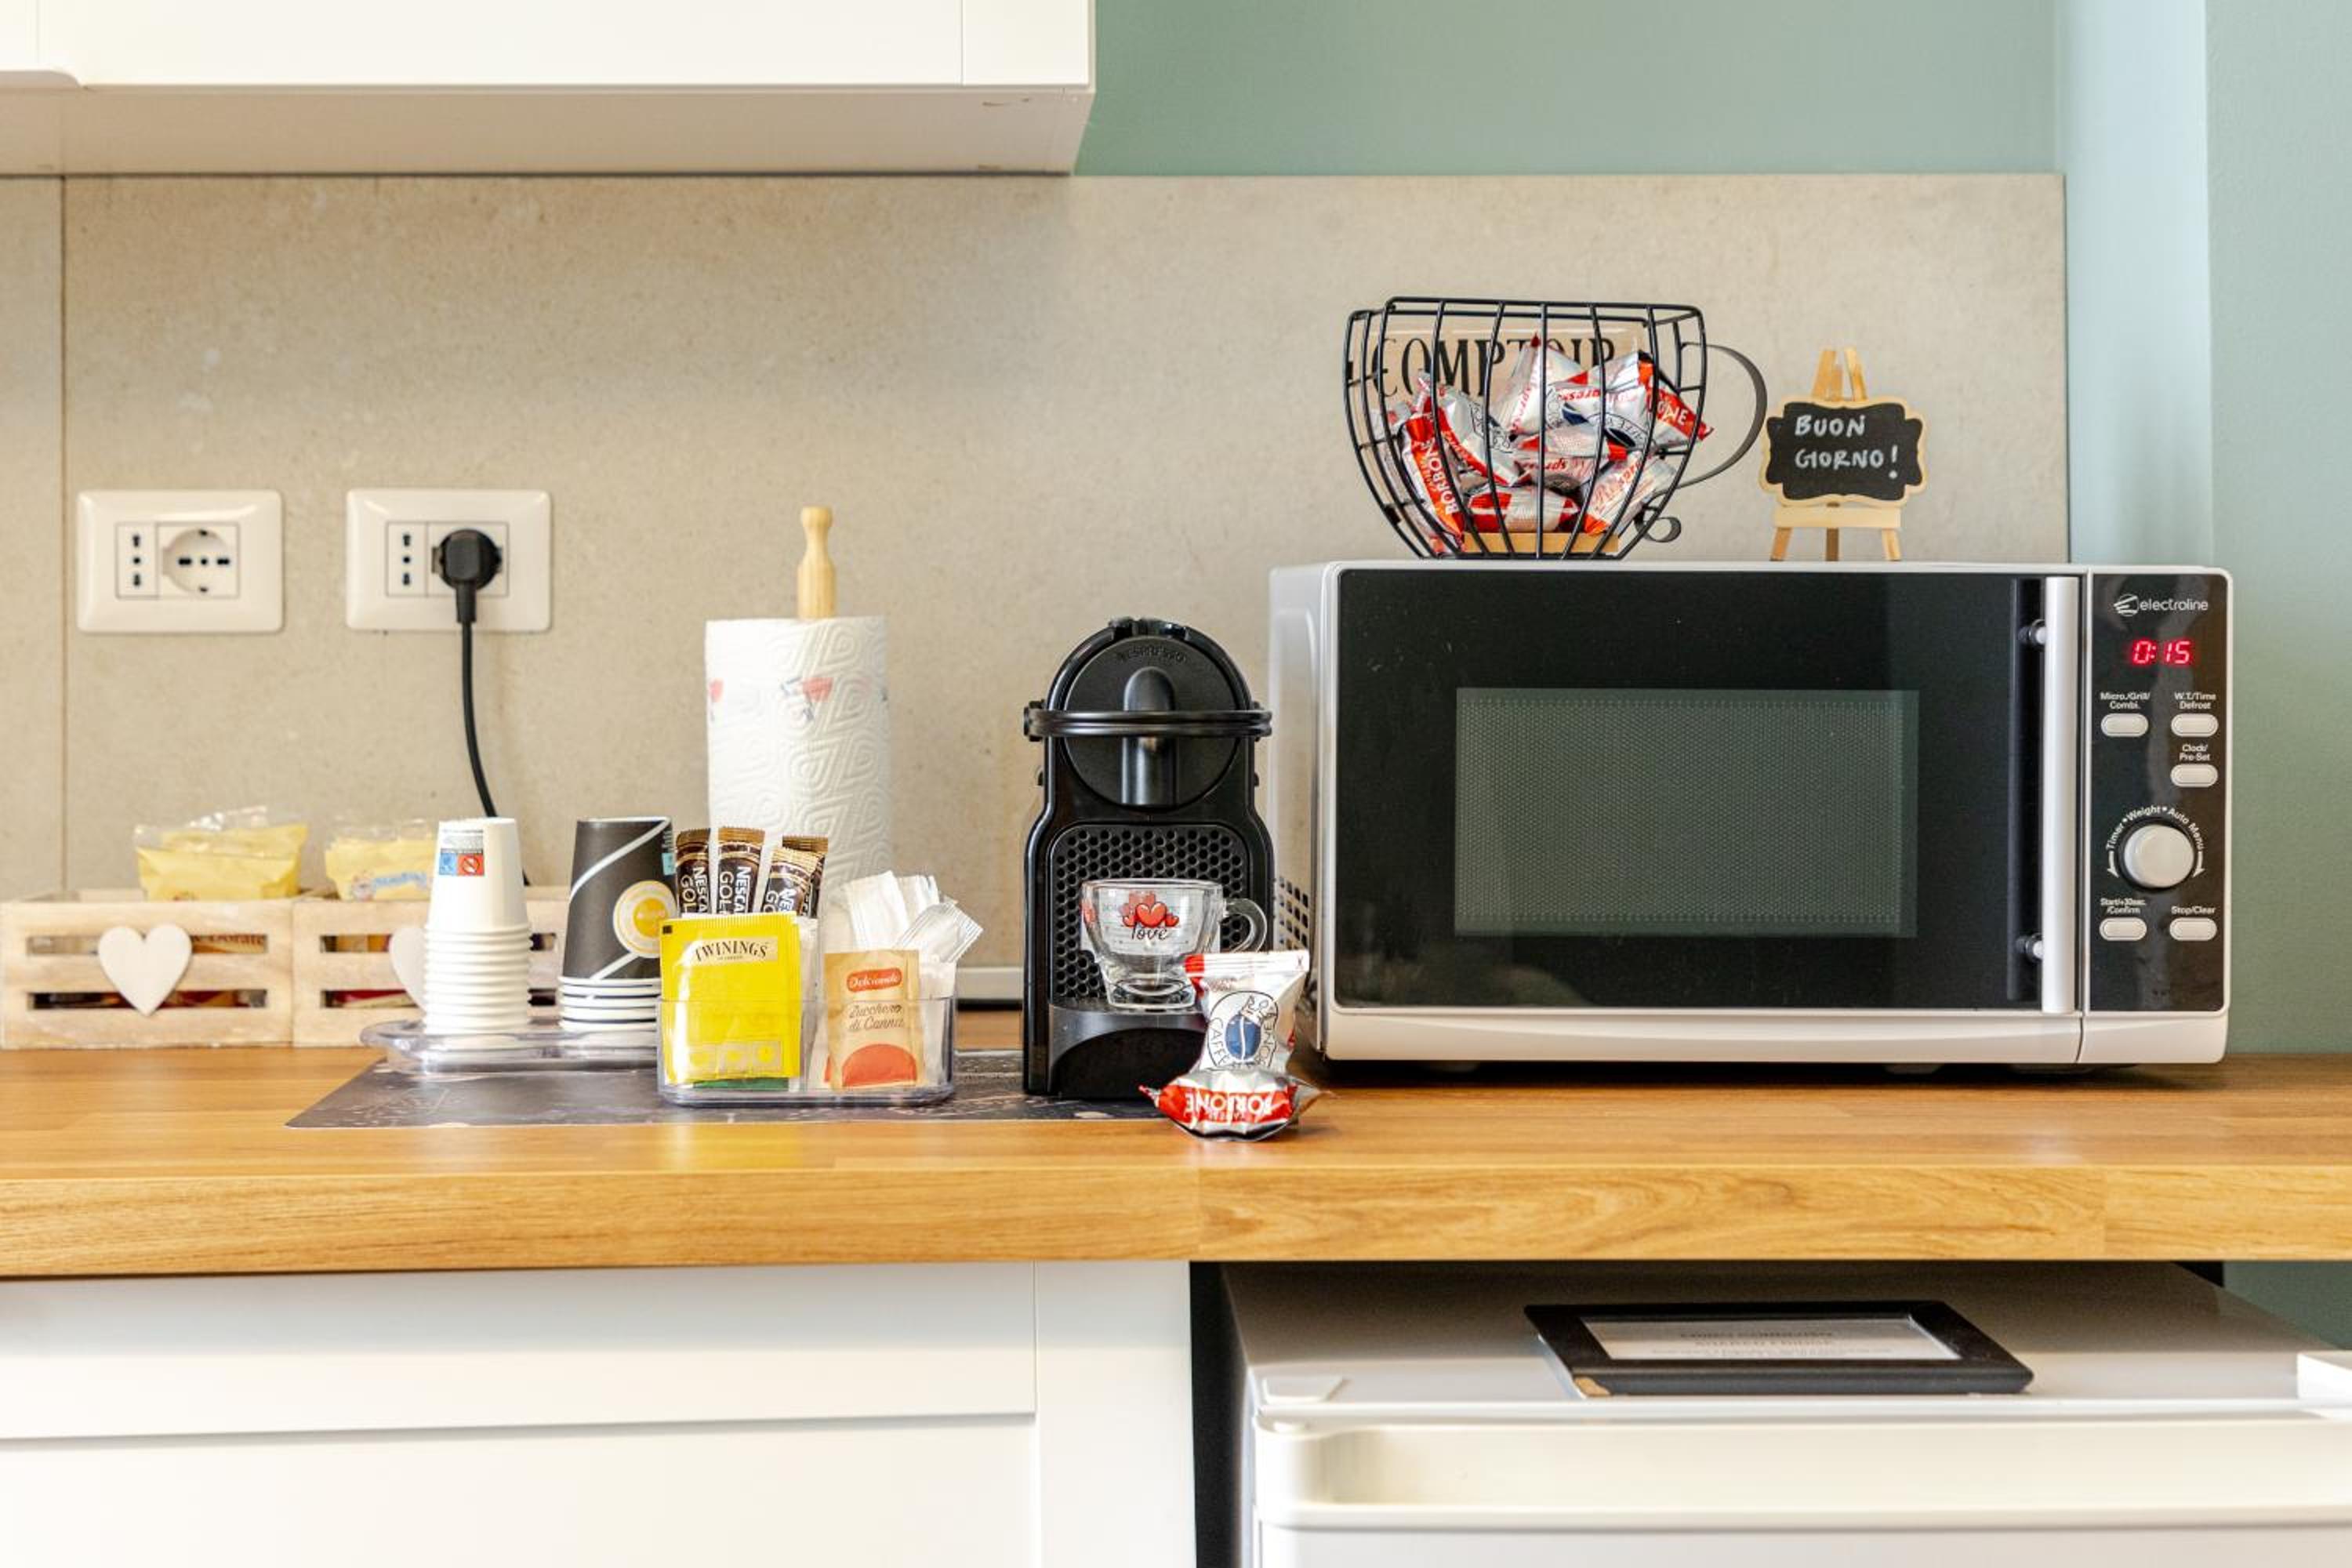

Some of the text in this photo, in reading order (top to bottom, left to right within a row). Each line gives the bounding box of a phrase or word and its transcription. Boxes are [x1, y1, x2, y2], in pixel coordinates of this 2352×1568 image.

[1795, 415, 1865, 437] BUON
[2140, 598, 2209, 611] electroline
[2132, 640, 2191, 664] 0:15
[2180, 701, 2211, 710] Defrost
[2106, 805, 2204, 851] Timer Weight Auto Menu
[2171, 906, 2216, 916] Stop/Clear
[1131, 921, 1167, 940] love
[695, 940, 768, 961] TWININGS
[864, 1016, 904, 1030] Canna
